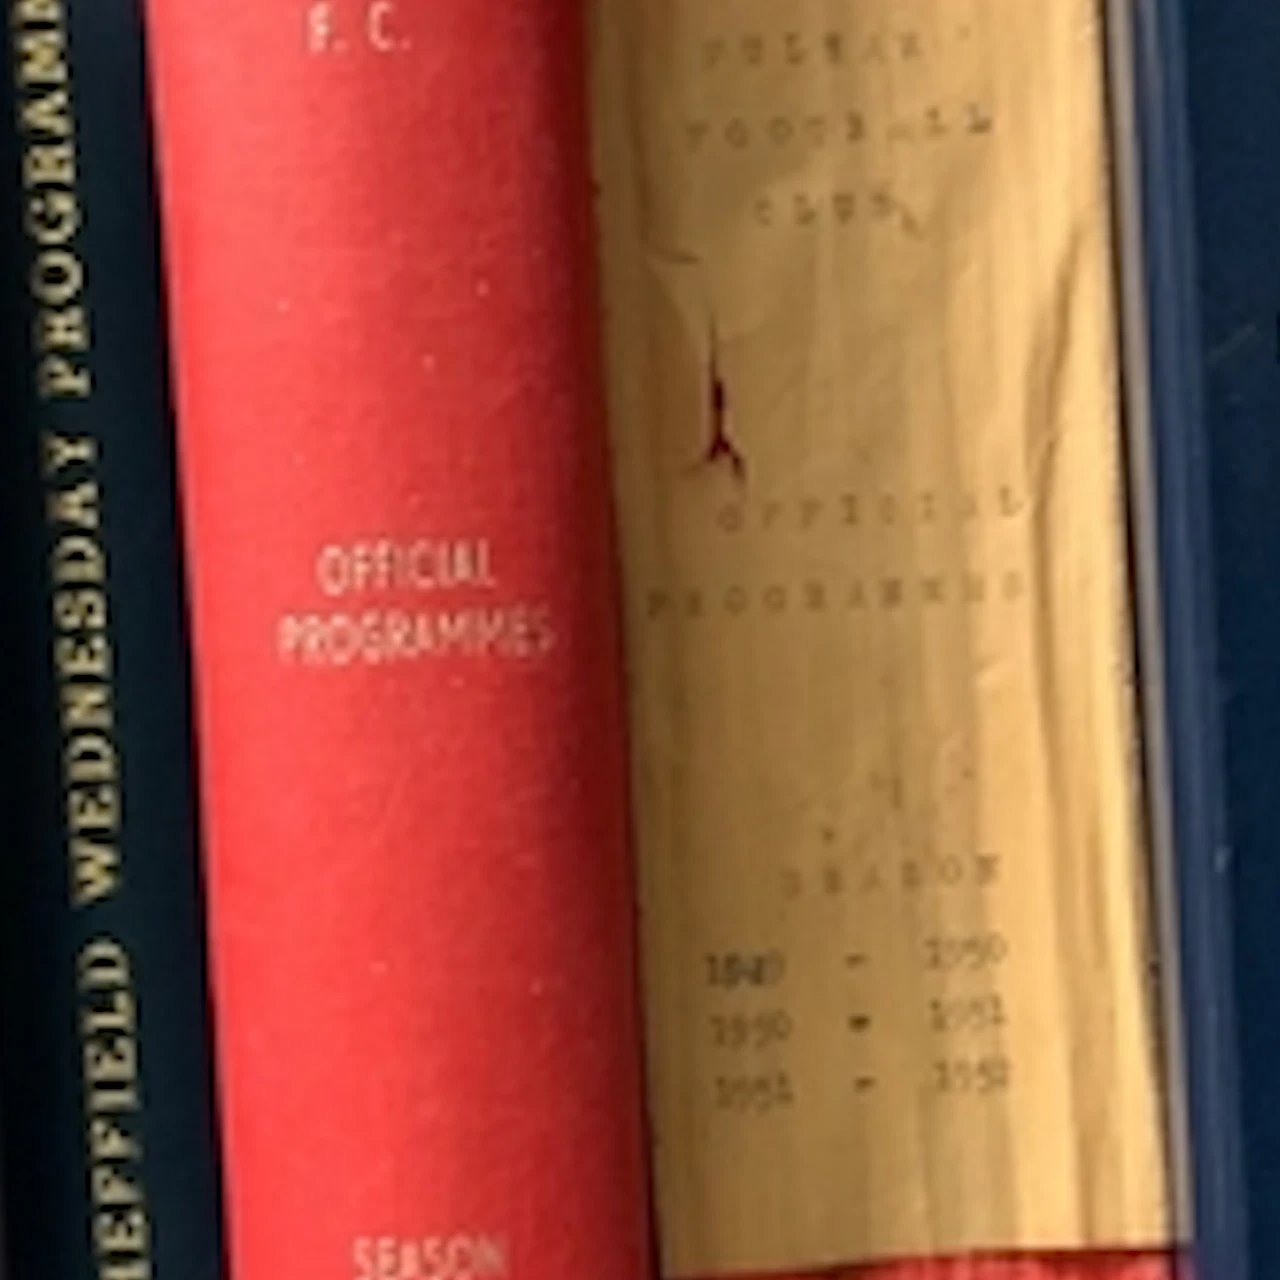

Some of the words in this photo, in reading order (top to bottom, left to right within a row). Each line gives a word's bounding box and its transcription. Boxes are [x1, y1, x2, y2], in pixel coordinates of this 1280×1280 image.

[316, 537, 497, 598] OFFICIAL
[278, 604, 556, 665] PROGRAMMES
[41, 428, 123, 908] WEDNESDAY
